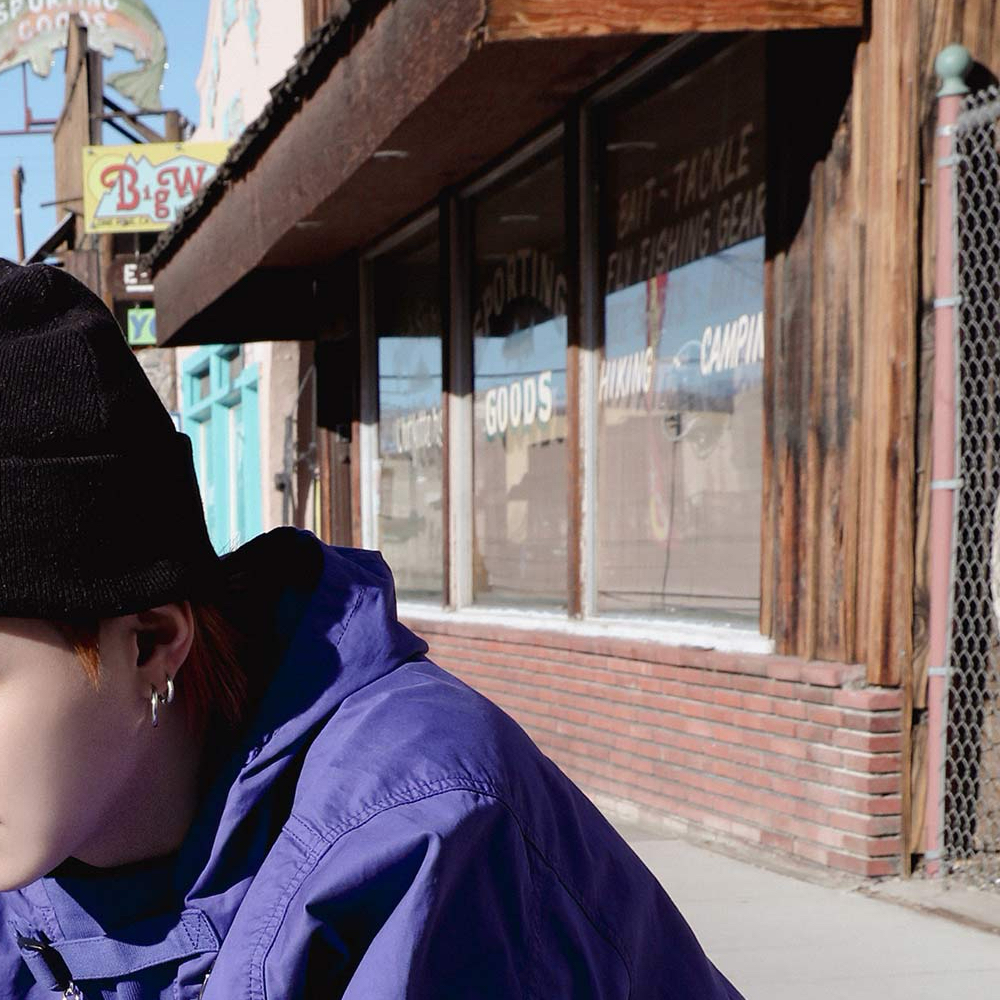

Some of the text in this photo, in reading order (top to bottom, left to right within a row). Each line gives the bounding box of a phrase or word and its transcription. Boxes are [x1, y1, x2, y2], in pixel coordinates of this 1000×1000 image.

[673, 122, 754, 213] TACKLE
[639, 209, 712, 283] FISHING
[716, 180, 766, 253] GEAR
[485, 370, 552, 437] GOODS
[599, 346, 654, 402] HIKING
